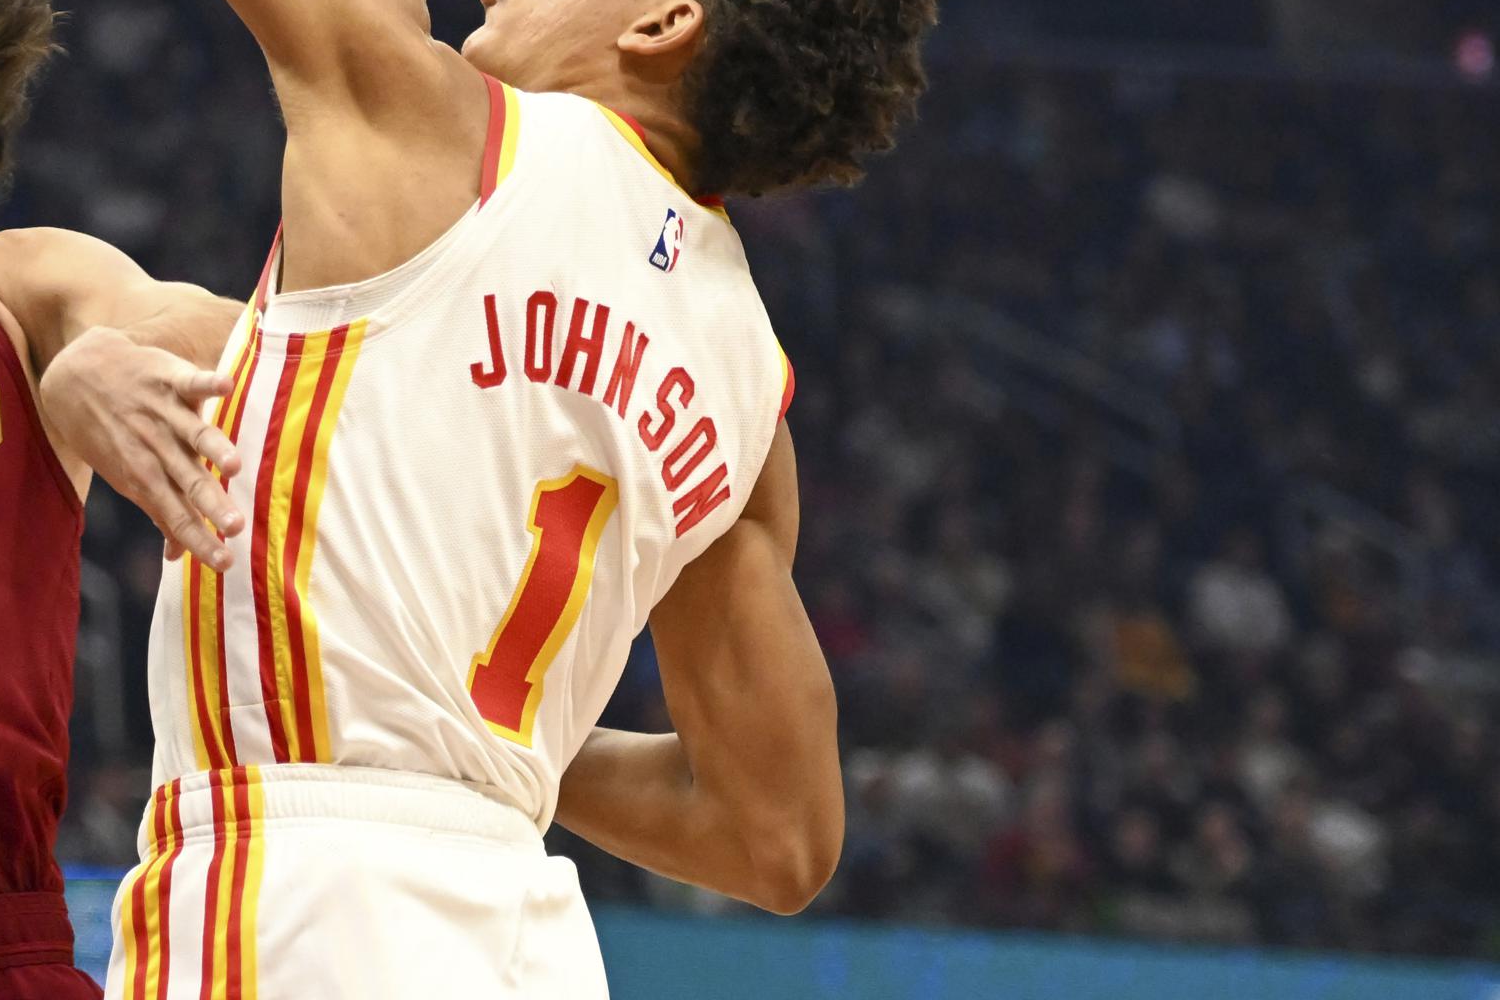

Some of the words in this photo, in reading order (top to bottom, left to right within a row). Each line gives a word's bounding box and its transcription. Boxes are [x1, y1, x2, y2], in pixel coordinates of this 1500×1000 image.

[651, 252, 668, 268] NBA
[470, 290, 731, 539] JOHNSON
[467, 463, 618, 748] 1
